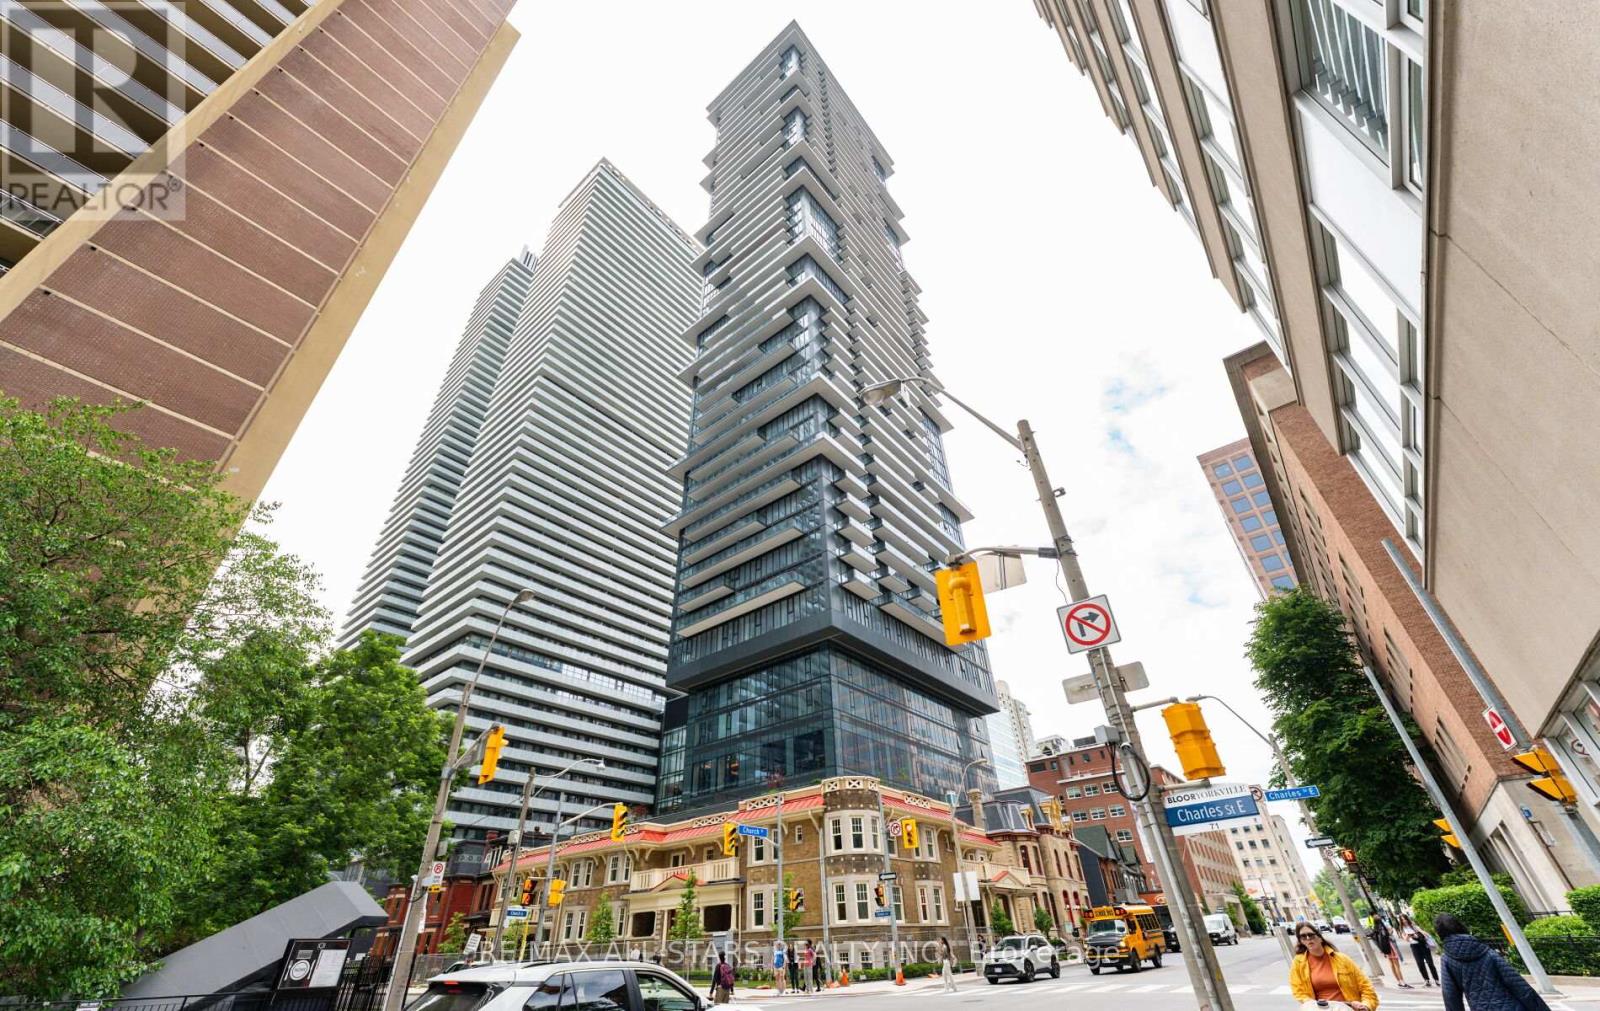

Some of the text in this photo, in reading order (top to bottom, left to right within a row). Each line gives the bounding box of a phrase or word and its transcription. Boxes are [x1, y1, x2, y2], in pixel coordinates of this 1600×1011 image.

[1268, 790, 1302, 800] Charles
[1177, 800, 1247, 822] Charles St E
[742, 825, 760, 836] Church
[1210, 822, 1220, 830] 71
